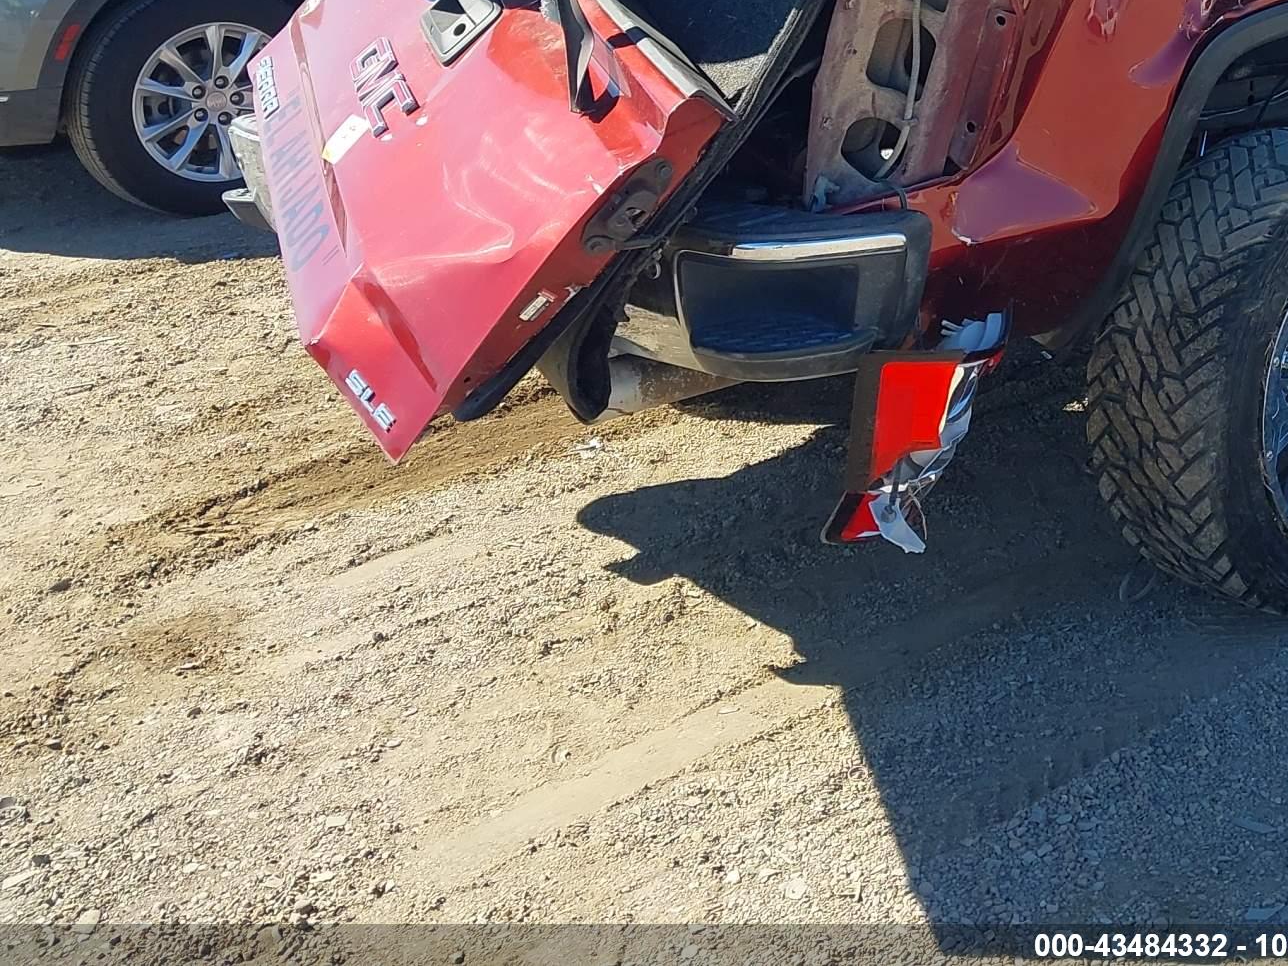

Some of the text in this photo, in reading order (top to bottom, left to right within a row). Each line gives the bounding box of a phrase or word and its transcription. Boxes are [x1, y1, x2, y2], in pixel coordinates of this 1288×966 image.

[256, 55, 281, 120] SIERRA
[349, 36, 421, 139] GMC
[341, 368, 397, 434] SLE
